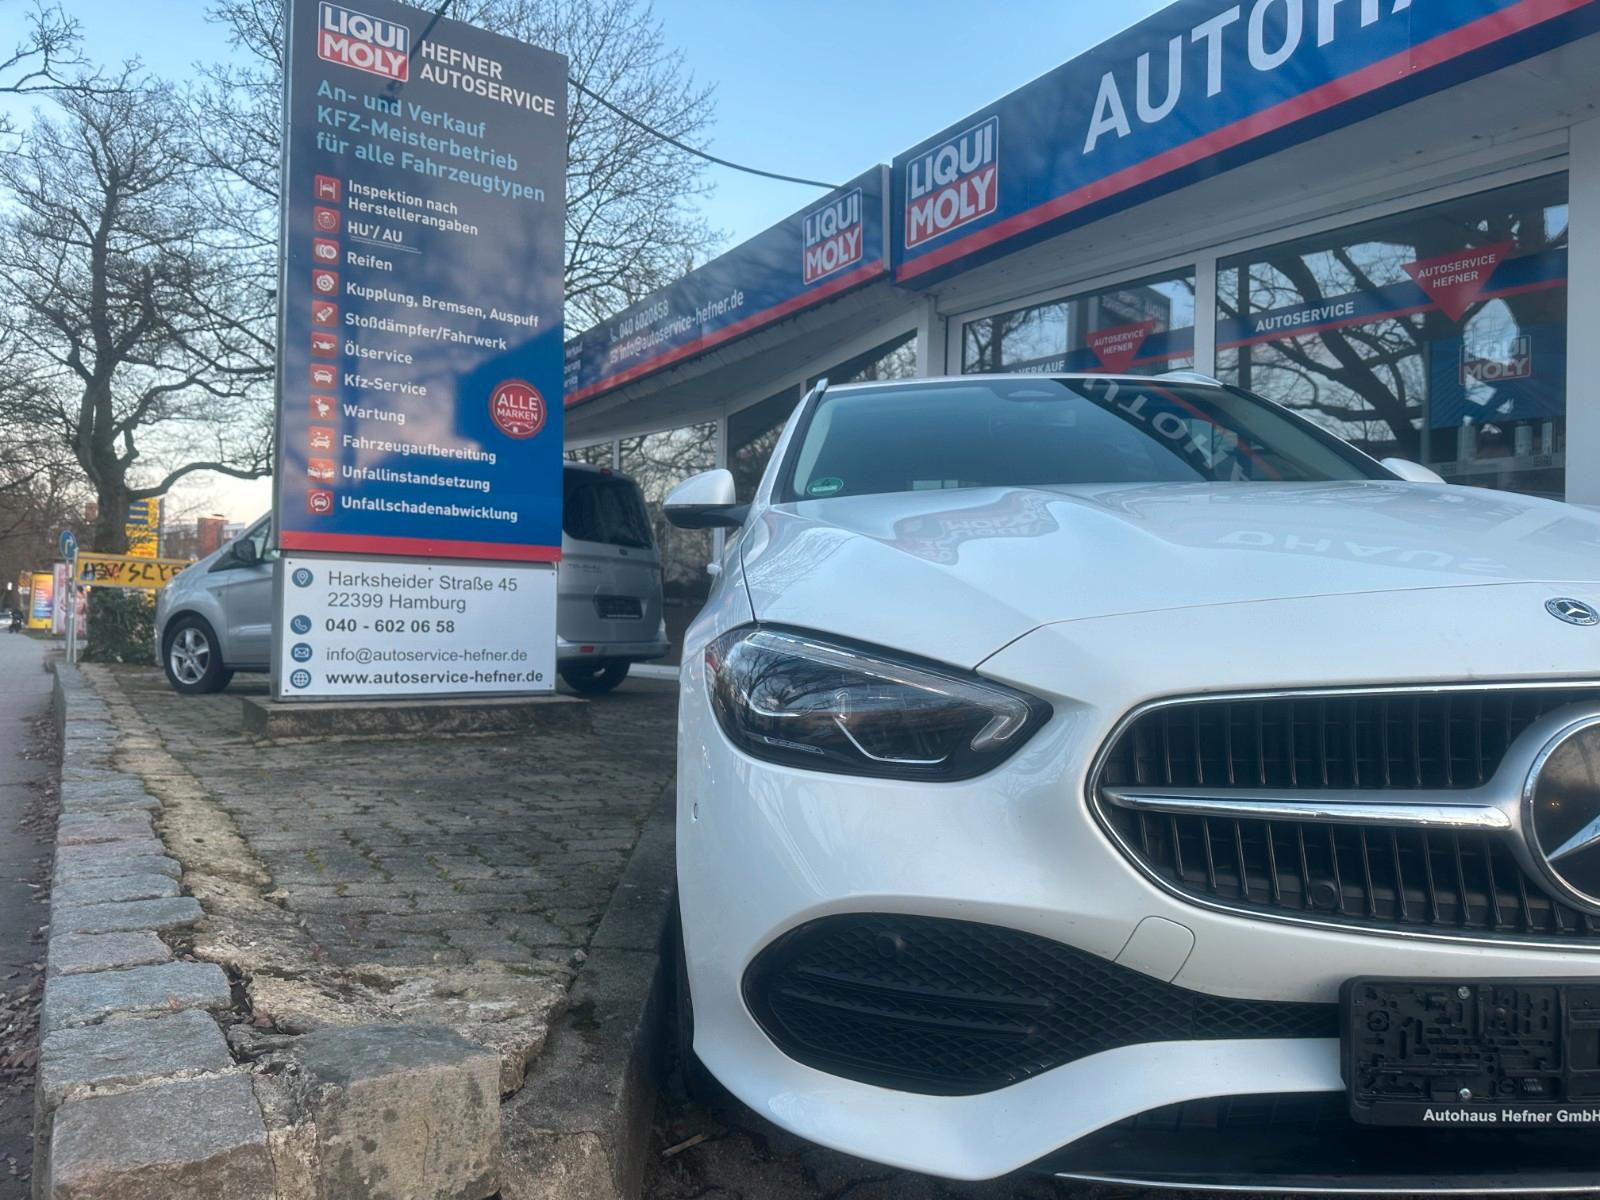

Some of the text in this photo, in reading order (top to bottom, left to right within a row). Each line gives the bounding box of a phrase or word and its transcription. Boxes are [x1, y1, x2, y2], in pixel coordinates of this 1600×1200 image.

[324, 5, 404, 51] LIQUI
[323, 35, 406, 77] MOLY
[421, 40, 502, 79] HEFNER
[420, 63, 555, 116] AUTOSERVICE
[1083, 0, 1412, 154] AUTOH
[317, 80, 486, 138] An- und Verkauf
[317, 105, 518, 171] KFZ-Meisterbetrieb
[317, 132, 545, 202] für alle Fahrzeugtypen
[912, 124, 993, 199] LIQUI
[348, 180, 458, 215] Inspektion nach
[911, 167, 995, 242] MOLY
[348, 197, 478, 235] Herstellerangaben
[806, 194, 858, 246] LIQUI
[347, 252, 393, 271] Reifen
[806, 227, 860, 279] MOLY
[1417, 253, 1496, 279] AUTOSERVICE
[1432, 270, 1480, 288] HEFNER
[347, 282, 539, 327] Kupplung, Bremsen, Auspuff
[1255, 301, 1355, 333] AUTOSERVICE
[345, 313, 507, 350] Stoßdämpfer/Fahrwerk
[1093, 329, 1145, 346] AUTOSERVICE
[344, 340, 413, 364] Ölservice
[1464, 357, 1528, 382] MOLY
[344, 374, 428, 396] Kfz-Service
[343, 403, 406, 426] Wartung
[497, 407, 538, 421] MARKEN
[498, 393, 538, 411] ALLE
[343, 435, 496, 464] Fahrzeugaufbereitung
[342, 466, 490, 493] Unfallinstandsetzung
[341, 496, 518, 523] Unfallschadenabwicklung
[328, 571, 518, 591] Harksheider Straße 45
[327, 592, 466, 613] 22399 Hamburg
[325, 618, 357, 633] 040
[374, 619, 405, 633] 602
[410, 620, 430, 633] 06
[436, 620, 455, 633] 58
[326, 646, 528, 664] info@autoservice-hefner.de
[325, 670, 544, 684] www.autoservice-hefner.de
[1423, 1108, 1600, 1123] Autohaus Hefner GmbH
